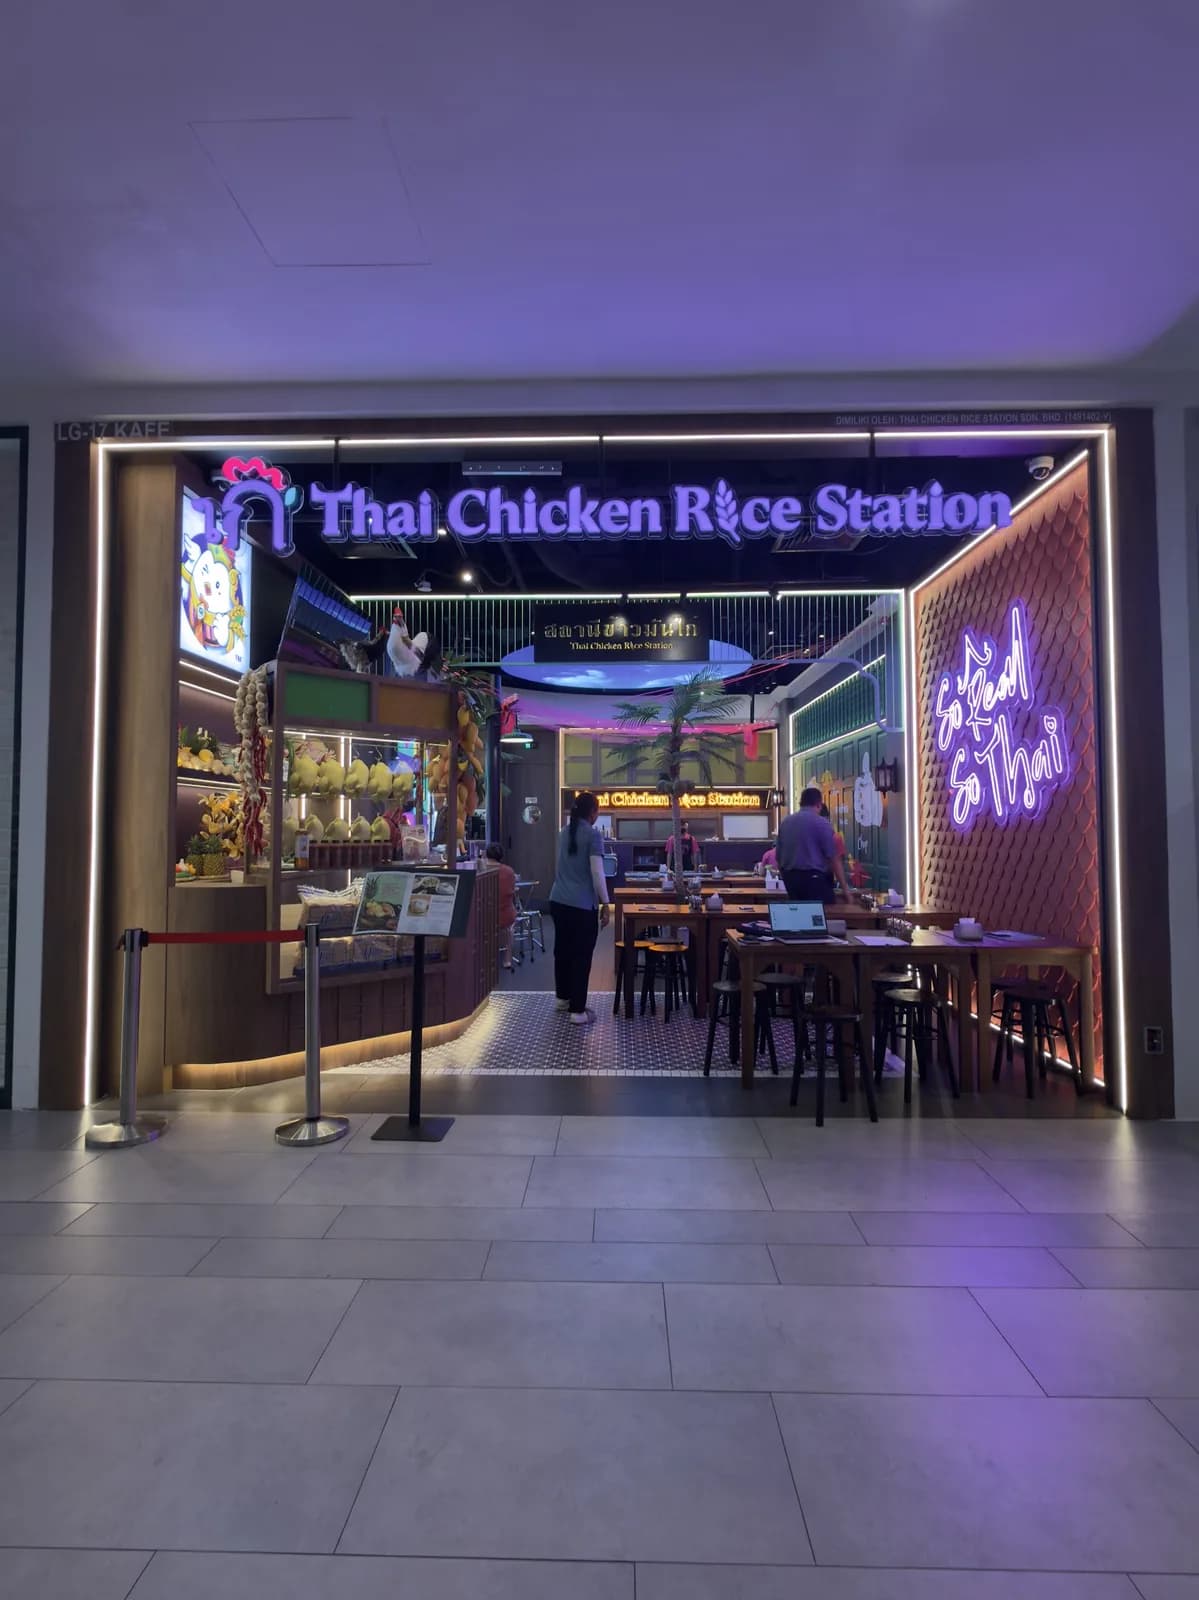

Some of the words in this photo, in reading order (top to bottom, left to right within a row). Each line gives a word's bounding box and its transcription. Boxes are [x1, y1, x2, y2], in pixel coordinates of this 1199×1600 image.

[900, 414, 919, 425] THAI
[921, 414, 958, 425] CHICKEN
[960, 413, 980, 424] RICE
[983, 413, 1018, 424] STATION
[57, 422, 108, 441] LG-17
[310, 481, 436, 541] Thai
[447, 484, 663, 541] Chicken
[815, 479, 1013, 536] Station
[569, 641, 589, 650] Thai
[590, 641, 622, 650] Chicken
[624, 641, 643, 650] Rice
[644, 641, 673, 650] Station
[936, 678, 963, 750] So
[950, 748, 981, 824] So
[974, 714, 1063, 816] Thai
[611, 791, 670, 807] Chicken
[708, 791, 760, 807] Station
